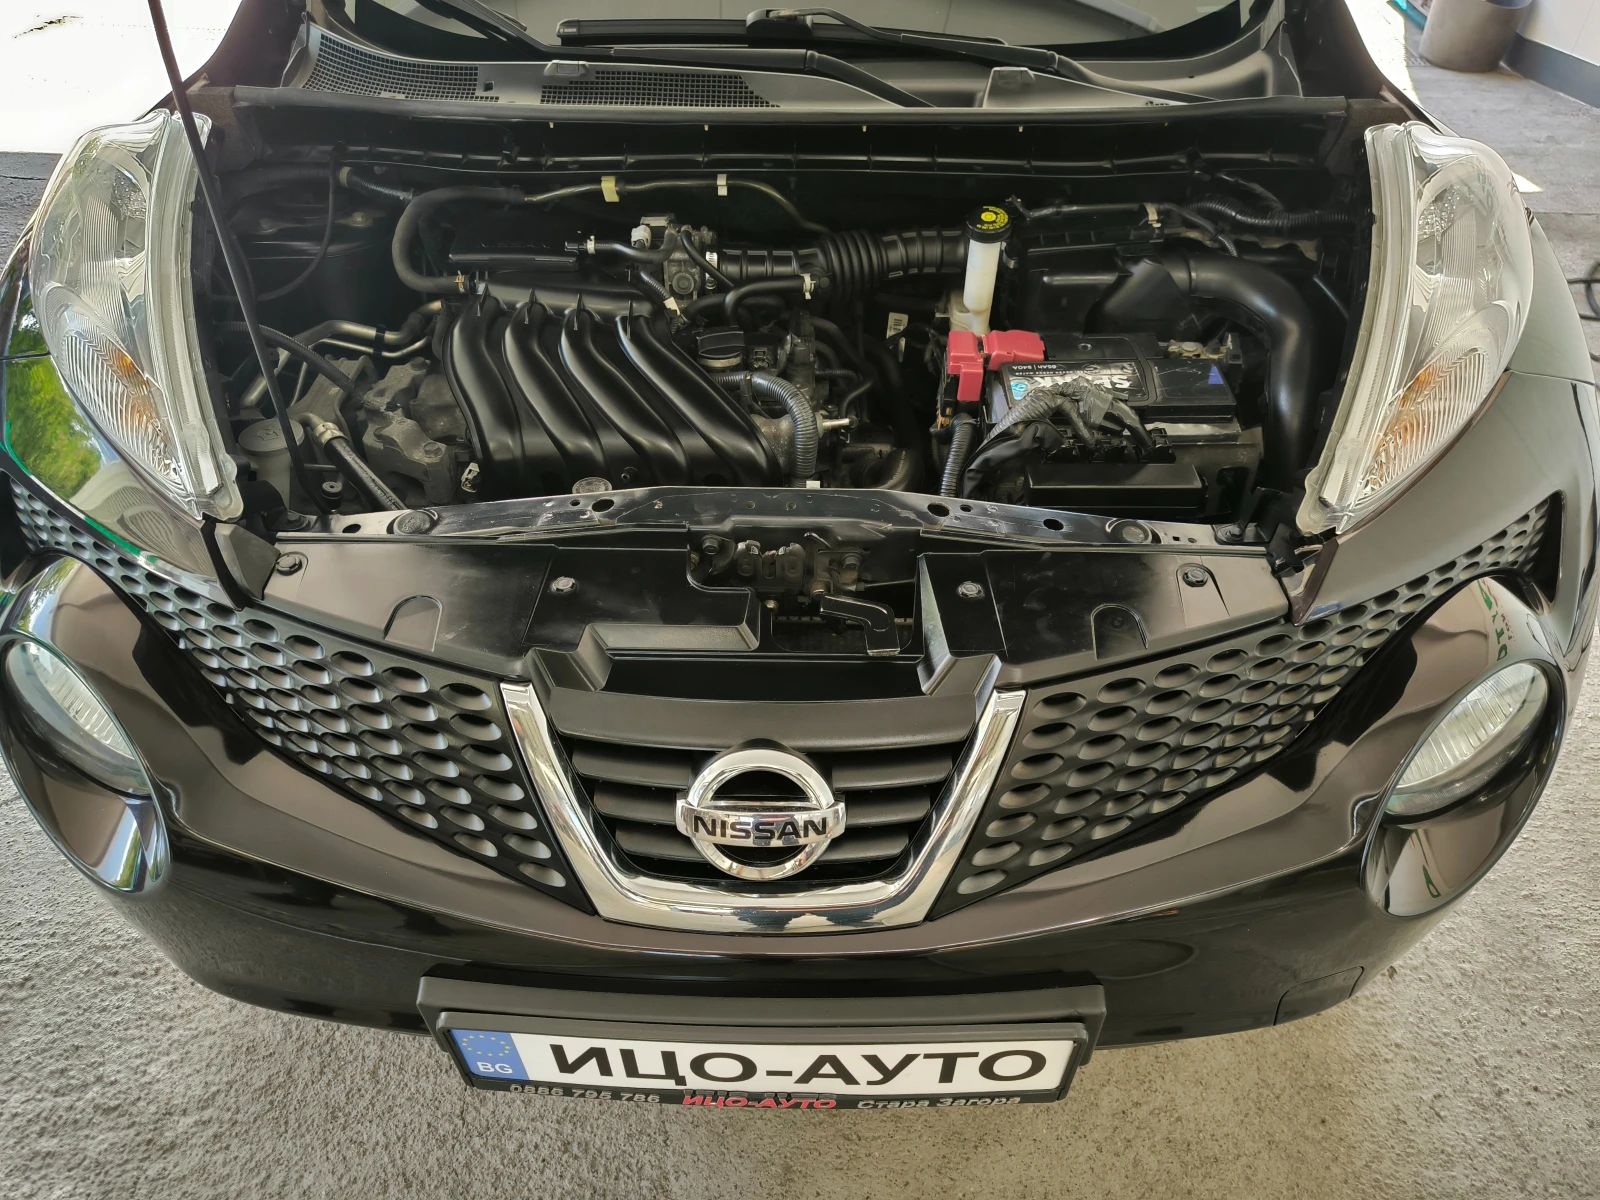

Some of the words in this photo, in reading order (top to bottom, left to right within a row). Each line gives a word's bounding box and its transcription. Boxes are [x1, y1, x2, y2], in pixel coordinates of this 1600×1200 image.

[693, 814, 827, 840] NISSAN
[476, 1061, 514, 1075] BG
[549, 1043, 1047, 1087] ИЦО-АУТО
[510, 1083, 564, 1096] 0886
[572, 1088, 612, 1100] 795
[620, 1092, 660, 1103] 786
[682, 1095, 837, 1109] ИЦО-АУТО
[857, 1100, 930, 1109] Стара
[936, 1096, 1021, 1107] Загора
